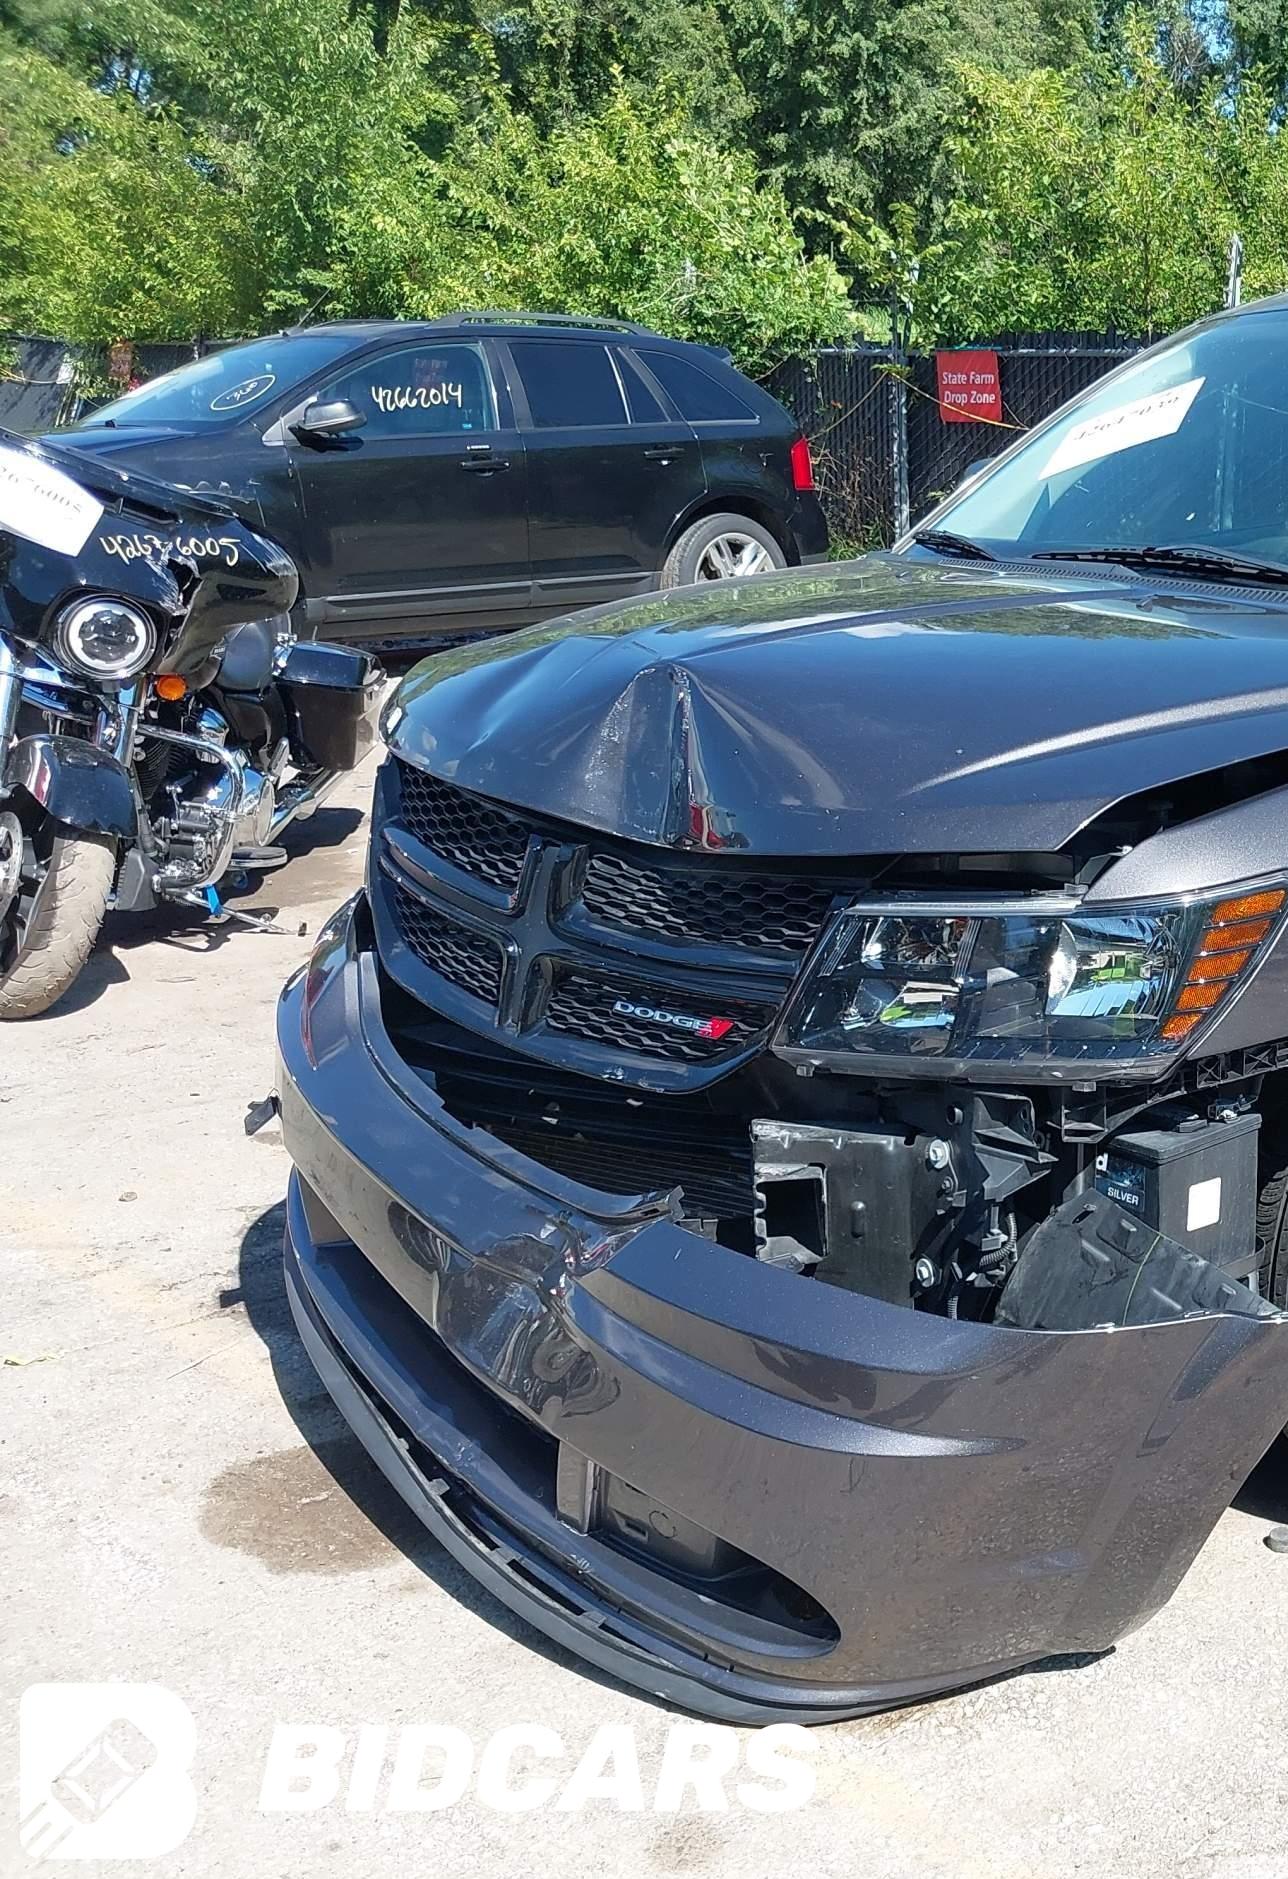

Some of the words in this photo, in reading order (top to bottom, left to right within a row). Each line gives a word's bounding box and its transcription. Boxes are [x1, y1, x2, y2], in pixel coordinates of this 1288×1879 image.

[942, 371, 967, 385] State
[970, 371, 995, 385] Farm
[371, 382, 463, 412] 42662014
[944, 390, 968, 407] Drop
[970, 390, 996, 404] Zone
[612, 1000, 713, 1035] DODGE
[1107, 1186, 1139, 1206] SILVER
